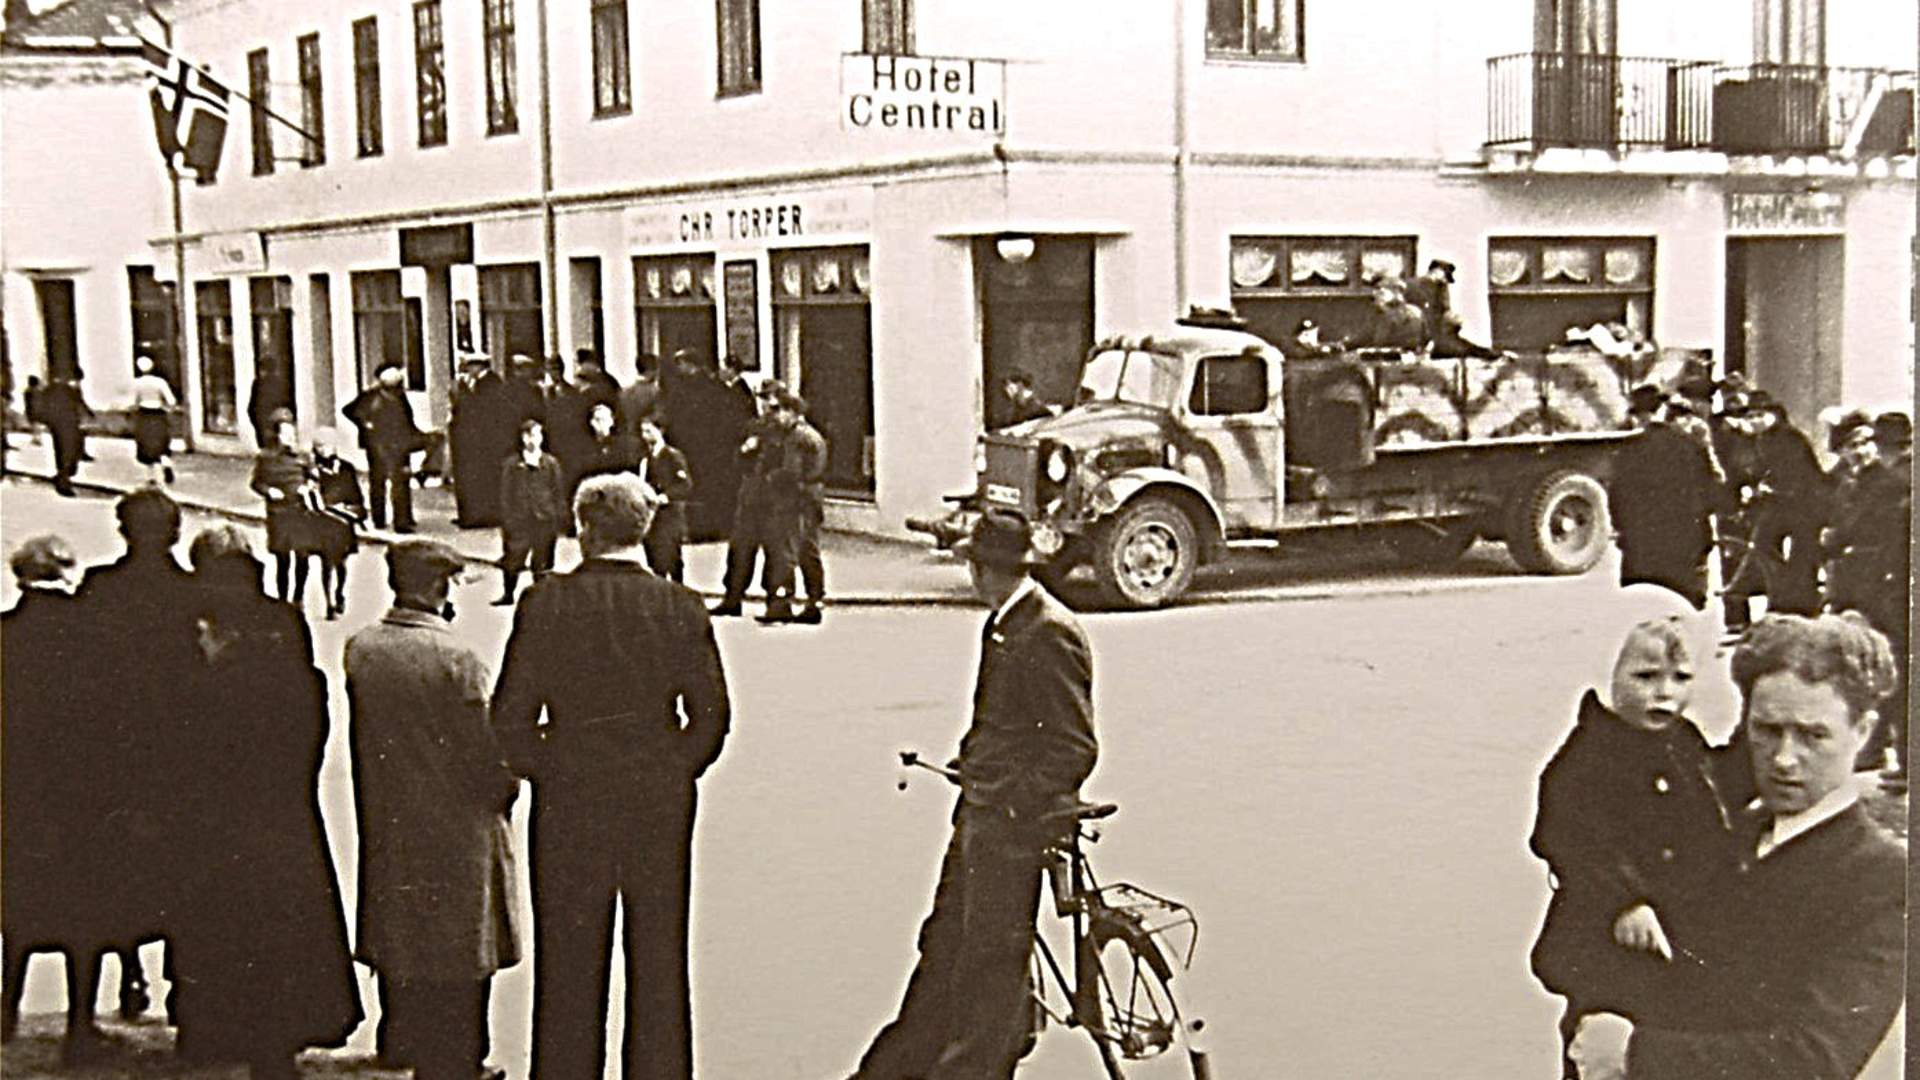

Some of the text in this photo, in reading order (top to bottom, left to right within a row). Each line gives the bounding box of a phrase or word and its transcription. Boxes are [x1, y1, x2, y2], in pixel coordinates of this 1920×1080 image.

[872, 54, 974, 94] Hotel
[850, 94, 999, 130] Central
[727, 204, 803, 240] TORPER
